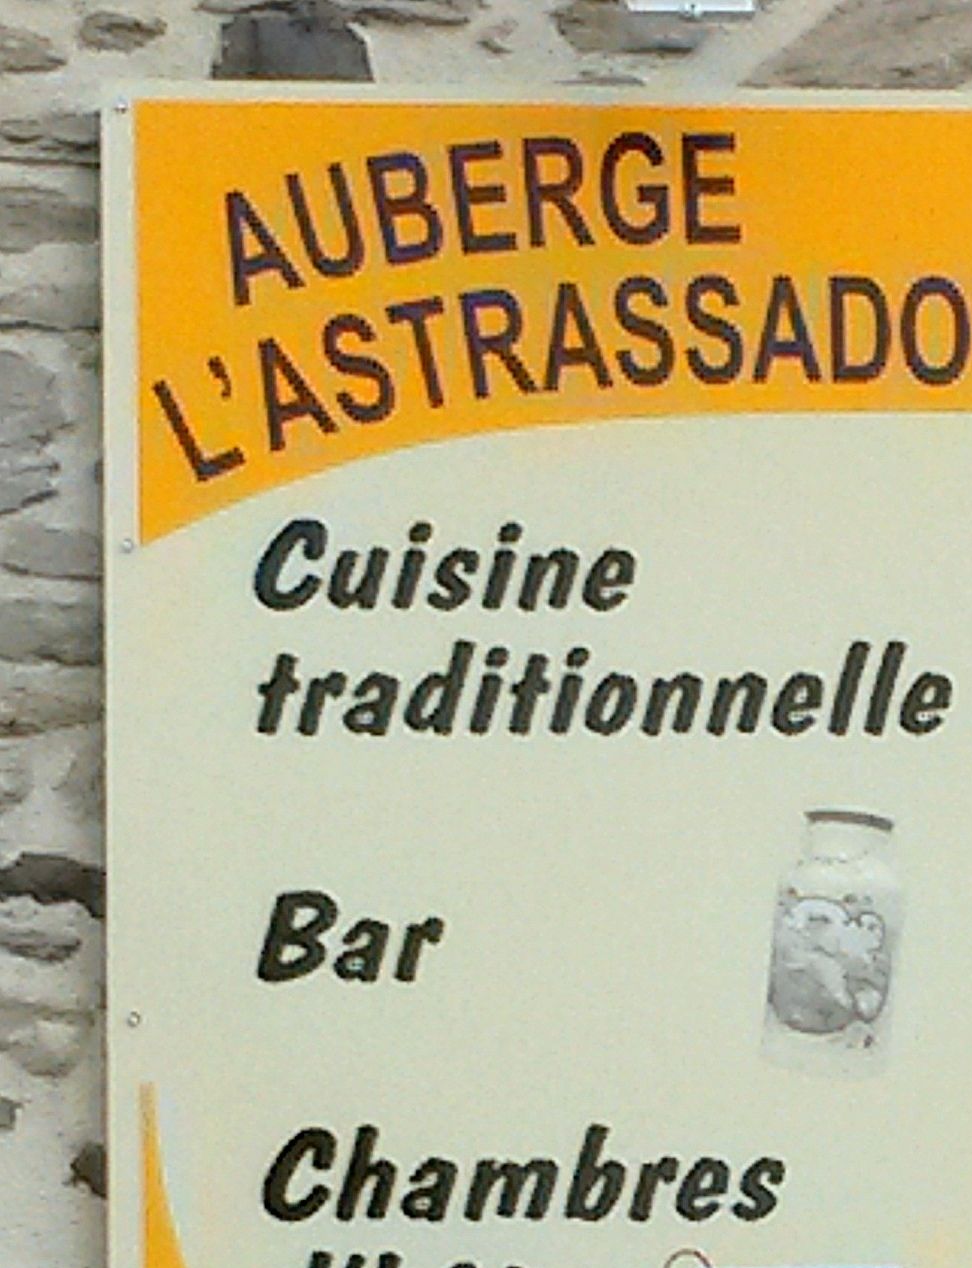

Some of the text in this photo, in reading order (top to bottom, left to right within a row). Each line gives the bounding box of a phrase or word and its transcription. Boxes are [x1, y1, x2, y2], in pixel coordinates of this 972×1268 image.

[225, 132, 741, 306] AUBERGE
[253, 519, 636, 612] Cuisine
[257, 639, 954, 737] traditionnelle
[256, 890, 444, 983] Bar
[262, 1124, 786, 1223] Chambres
